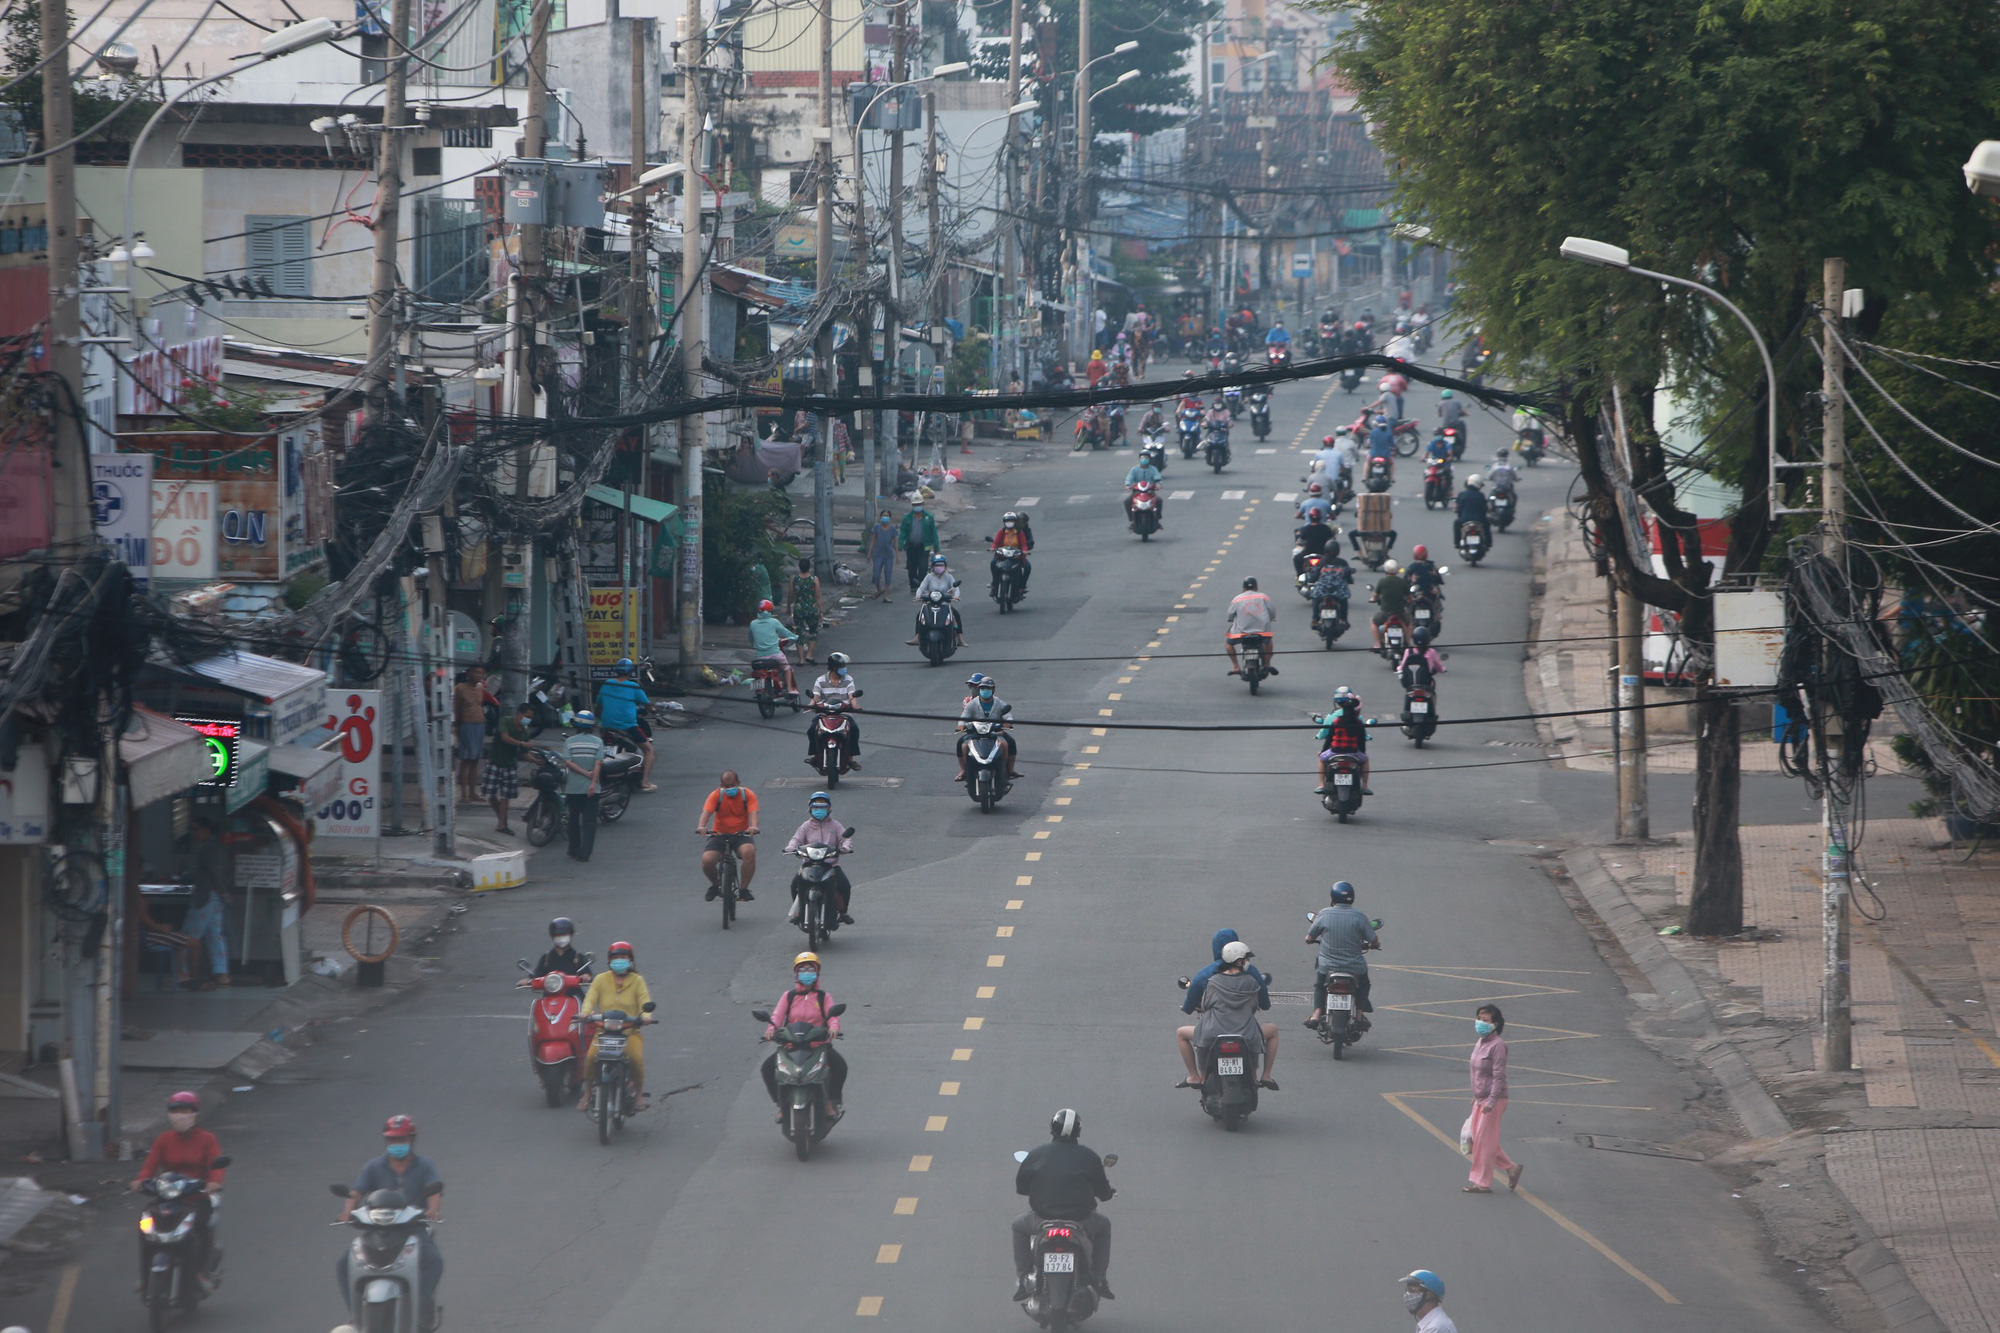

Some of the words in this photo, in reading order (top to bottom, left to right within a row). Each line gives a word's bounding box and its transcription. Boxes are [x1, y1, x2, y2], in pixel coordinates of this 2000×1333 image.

[94, 459, 143, 478] THUỐC
[152, 483, 208, 520] CẦM
[592, 508, 613, 520] Nail
[152, 526, 201, 567] ĐỒ
[587, 610, 608, 619] TAY
[1049, 1254, 1070, 1263] 59-F2
